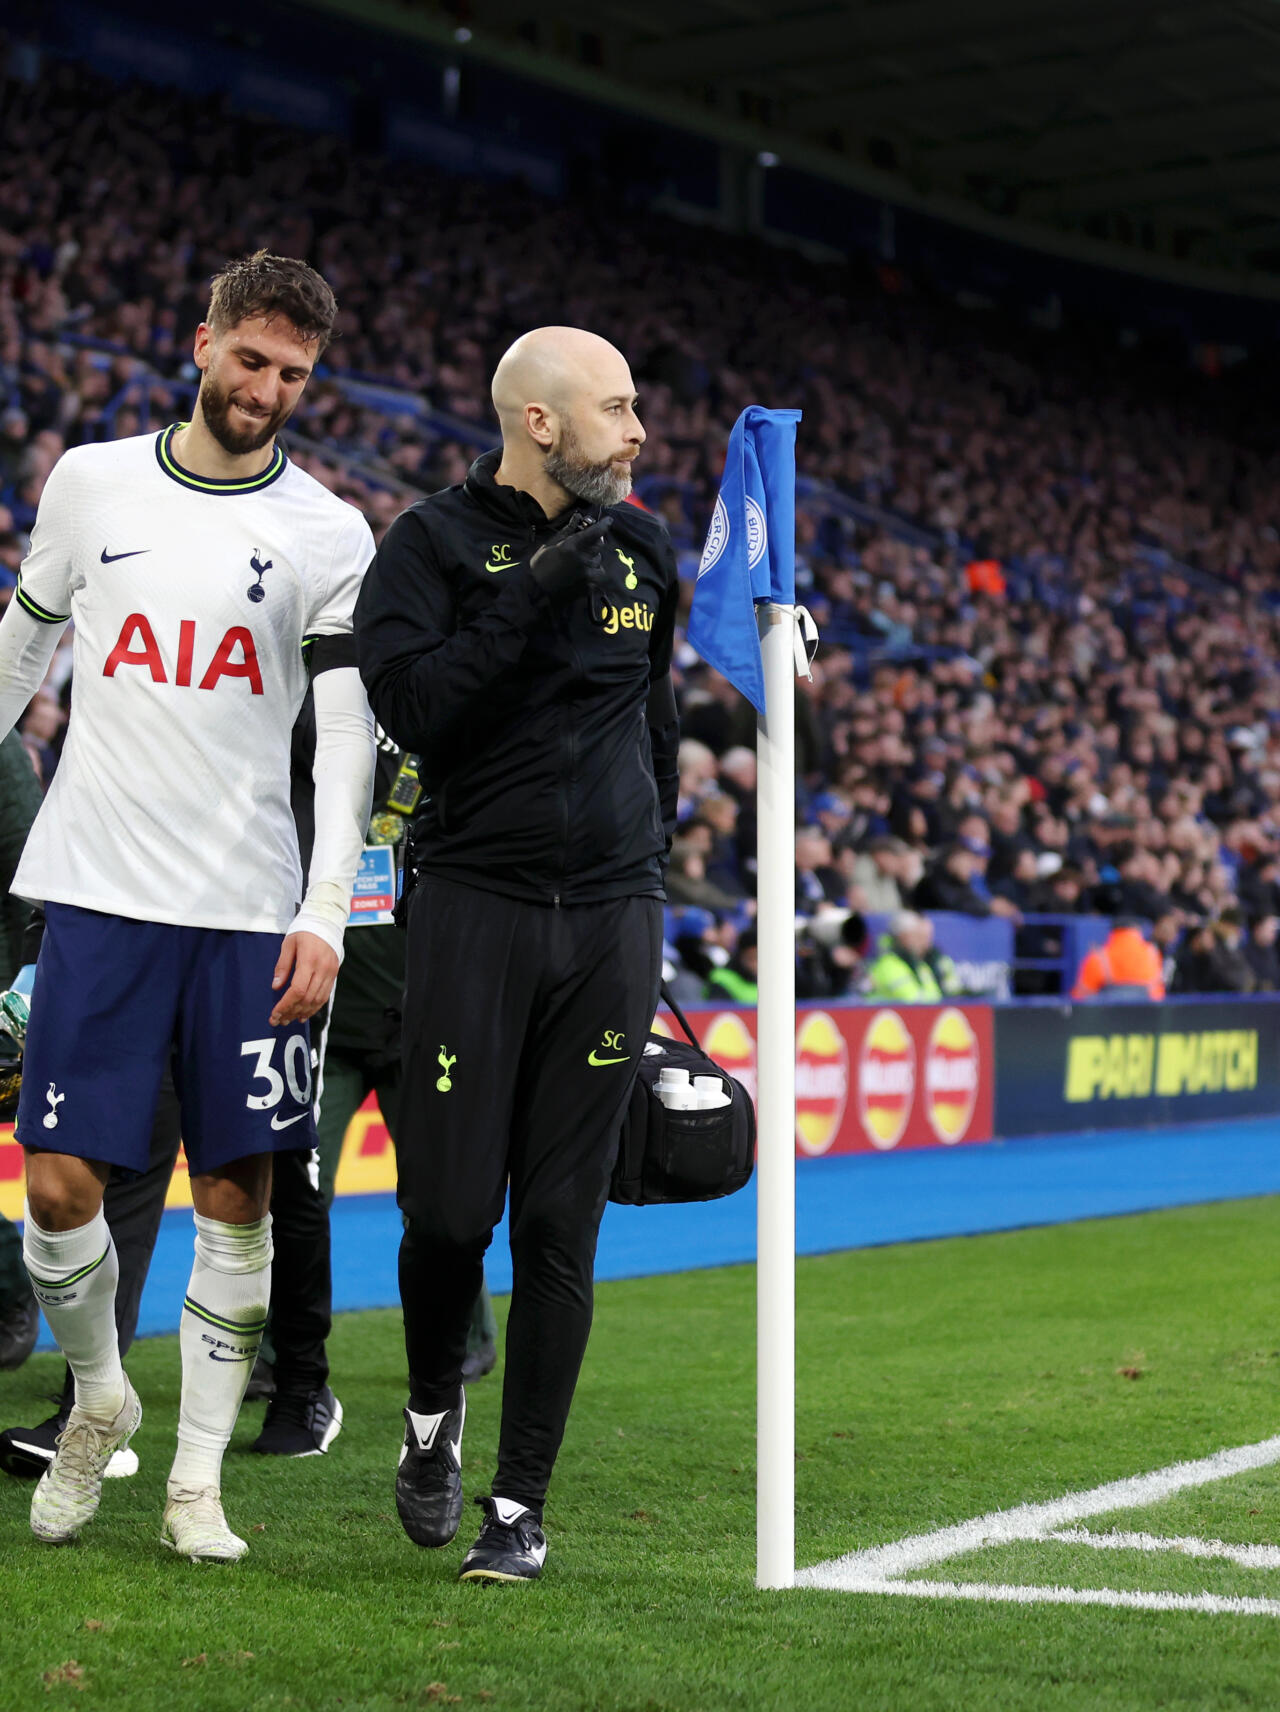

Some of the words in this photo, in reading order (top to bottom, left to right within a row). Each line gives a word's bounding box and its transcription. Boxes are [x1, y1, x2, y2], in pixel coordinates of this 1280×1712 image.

[748, 517, 759, 551] CLUB
[491, 544, 512, 562] SC
[601, 602, 655, 635] getir
[102, 613, 264, 696] AIA
[601, 1030, 625, 1050] SC
[240, 1034, 312, 1110] 30
[1066, 1034, 1155, 1102] PARI
[1155, 1029, 1259, 1097] MATCH
